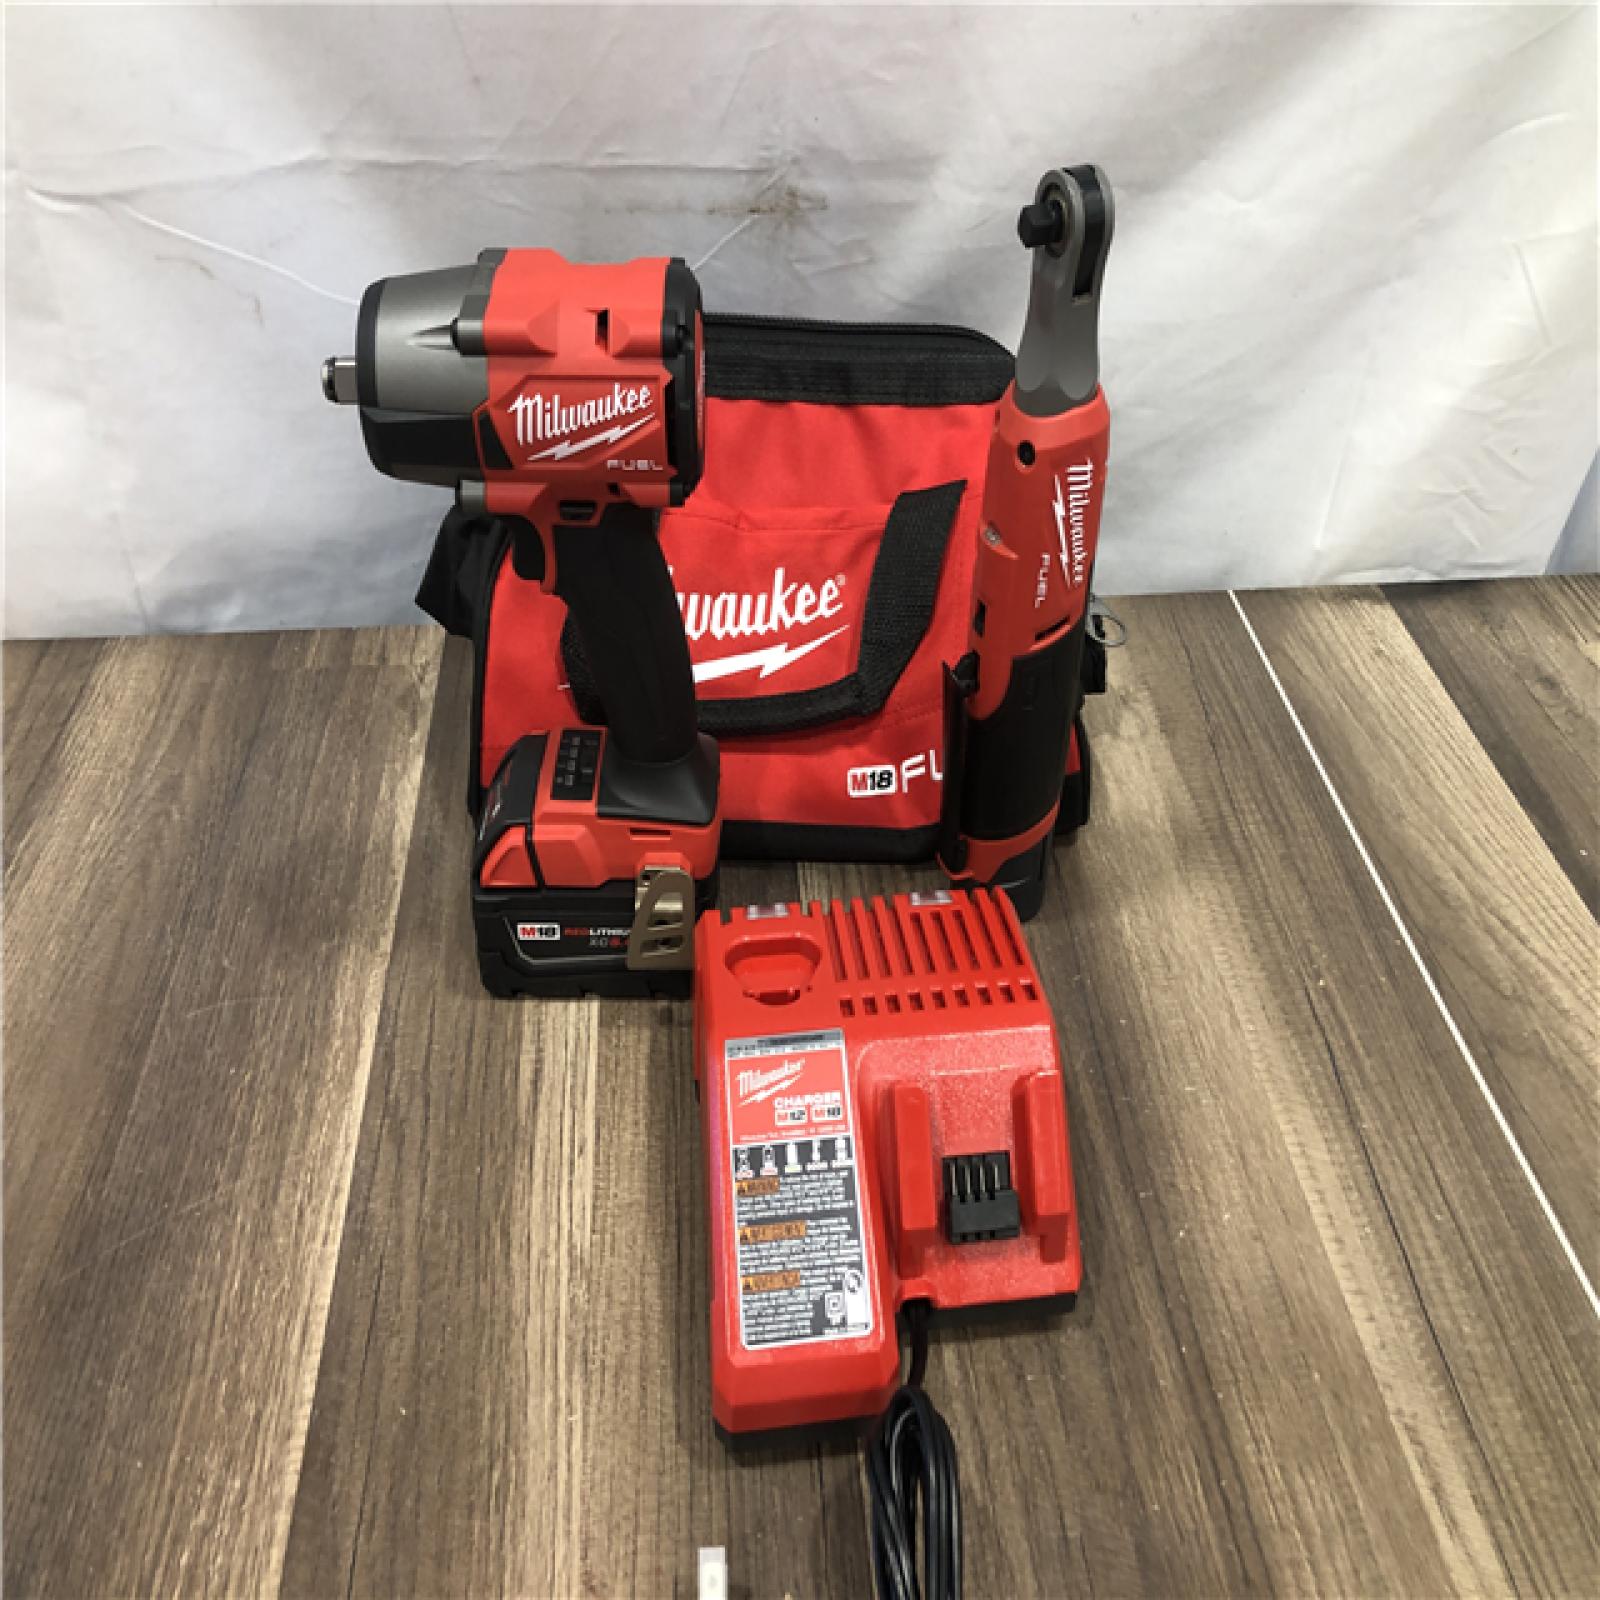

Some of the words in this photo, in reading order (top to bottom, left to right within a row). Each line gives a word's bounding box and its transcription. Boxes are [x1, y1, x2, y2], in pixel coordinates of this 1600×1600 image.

[507, 382, 654, 446] Milwaukee
[607, 459, 664, 471] FUEL
[1066, 457, 1094, 588] Milwaukee
[675, 566, 843, 641] waukee
[1034, 553, 1051, 609] FUEL
[850, 768, 893, 793] M18
